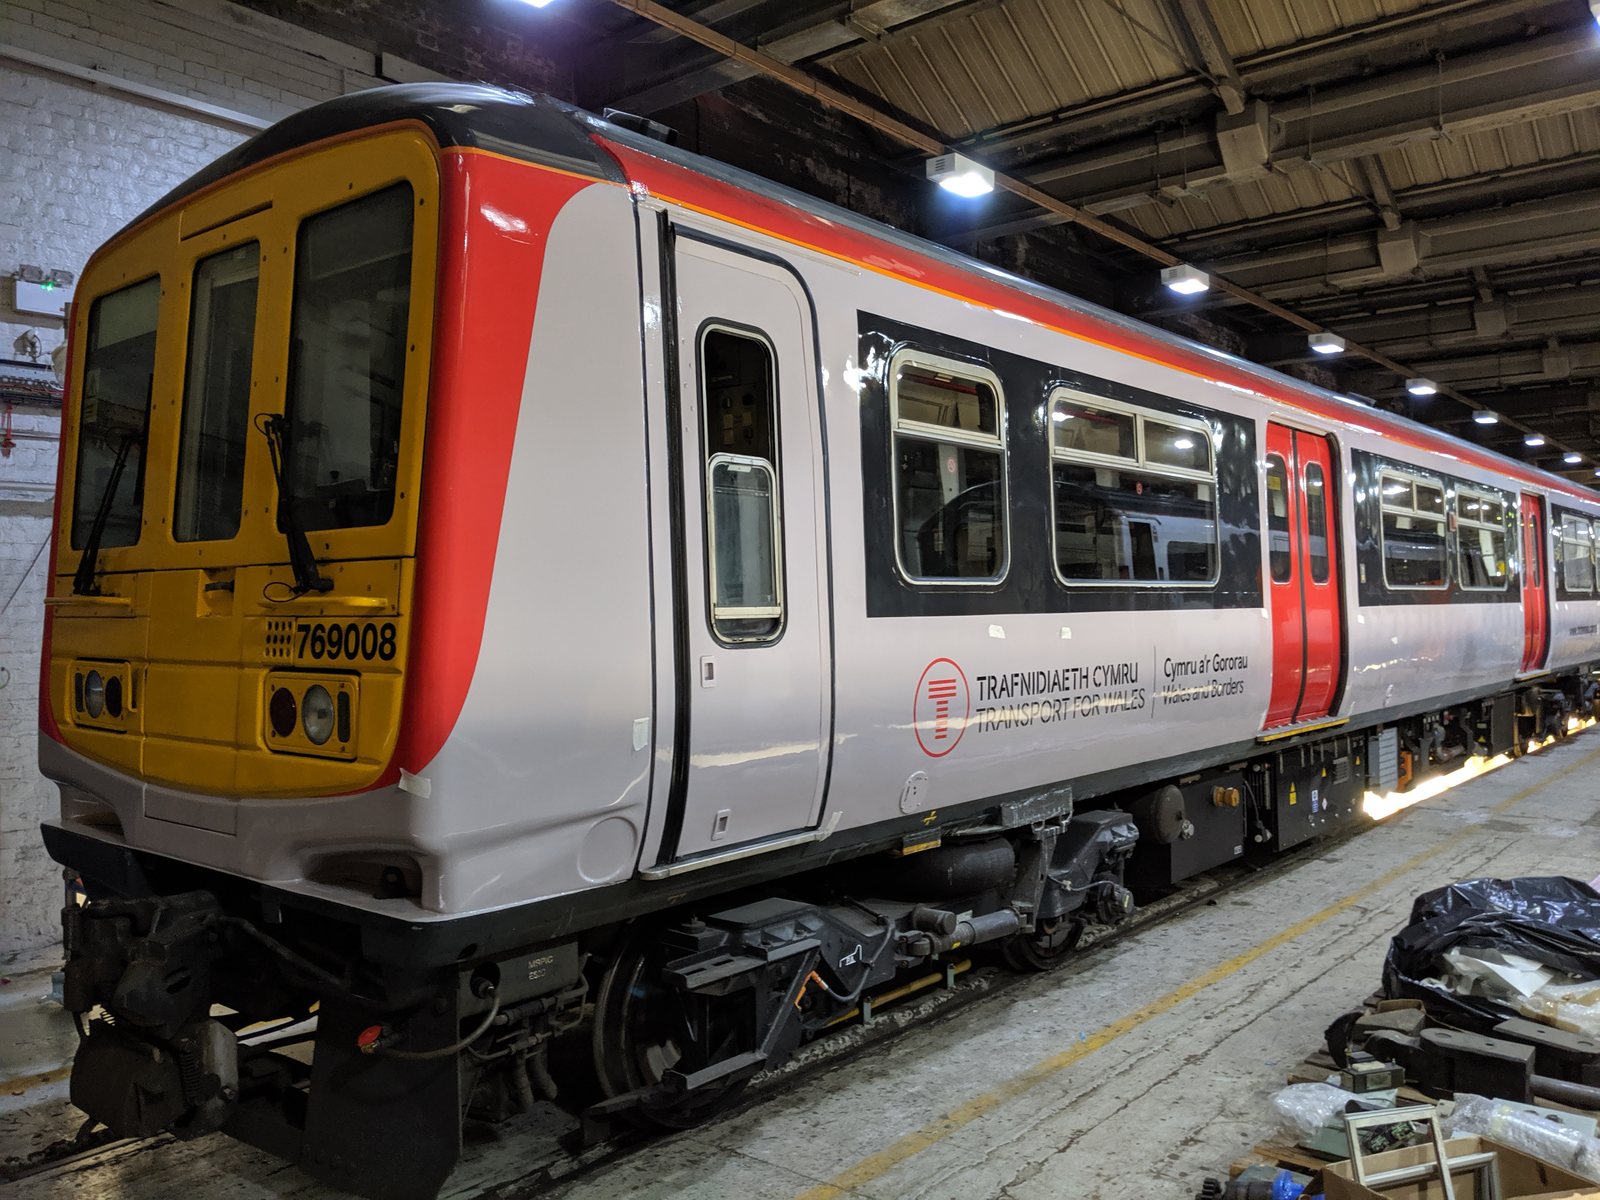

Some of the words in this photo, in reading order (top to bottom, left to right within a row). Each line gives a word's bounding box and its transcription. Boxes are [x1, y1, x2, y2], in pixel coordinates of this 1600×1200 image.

[297, 622, 397, 661] 769008
[976, 666, 1089, 701] TRAFNIDIAETH
[1092, 662, 1139, 688] CYMRU
[1163, 657, 1197, 682] Cymru
[1212, 653, 1248, 672] Gororau
[976, 697, 1071, 733] TRANSPORT
[1072, 694, 1100, 719] FOR
[1103, 688, 1146, 714] WALES
